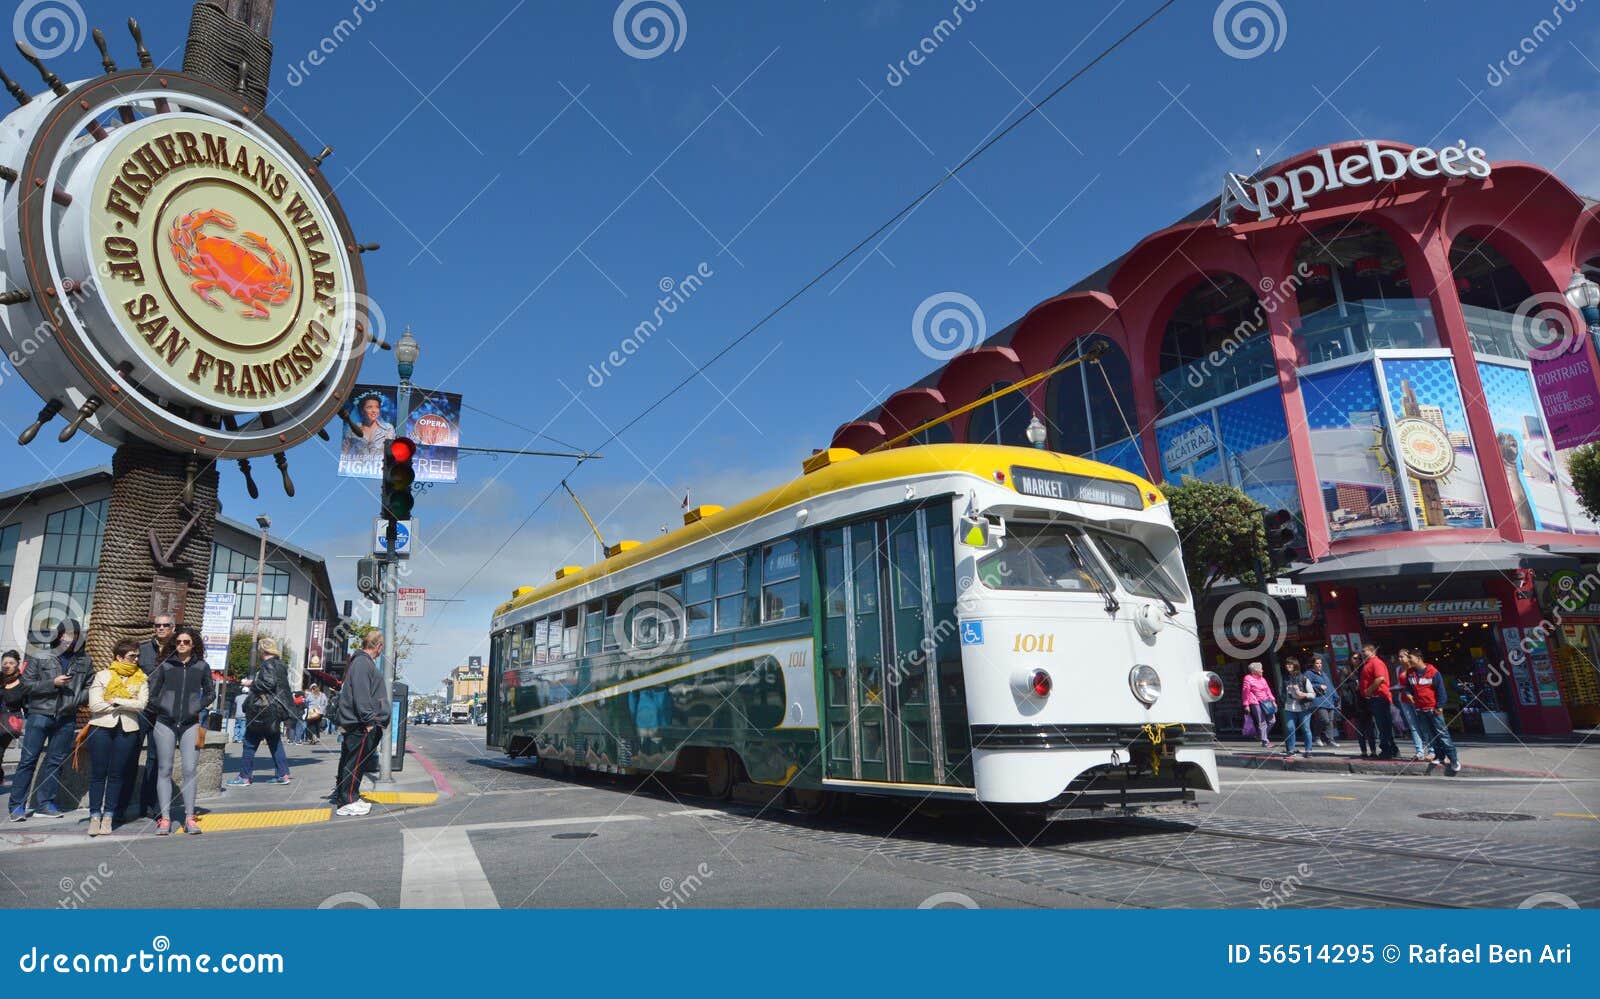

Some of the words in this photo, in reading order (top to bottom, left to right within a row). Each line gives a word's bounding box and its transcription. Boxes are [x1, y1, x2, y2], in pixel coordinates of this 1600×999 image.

[1216, 138, 1492, 228] Applebee's
[105, 131, 289, 226] FISHERMANS
[284, 191, 337, 318] WHARF
[104, 235, 145, 286] OF
[123, 292, 191, 368] SAN
[187, 318, 331, 400] FRANCISCO
[1537, 360, 1589, 386] PORTRAITS
[1542, 390, 1569, 407] OTHER
[1546, 393, 1594, 417] LIKENESSES
[419, 418, 447, 428] OPERA
[1167, 430, 1216, 463] ALCATRAZ
[338, 460, 384, 475] FIGAR
[1022, 477, 1064, 498] MARKET
[1274, 585, 1297, 595] Taylor
[1371, 603, 1422, 614] WHARF
[1427, 600, 1490, 612] CENTRAL
[1013, 633, 1055, 653] 1011
[788, 651, 807, 668] 1011
